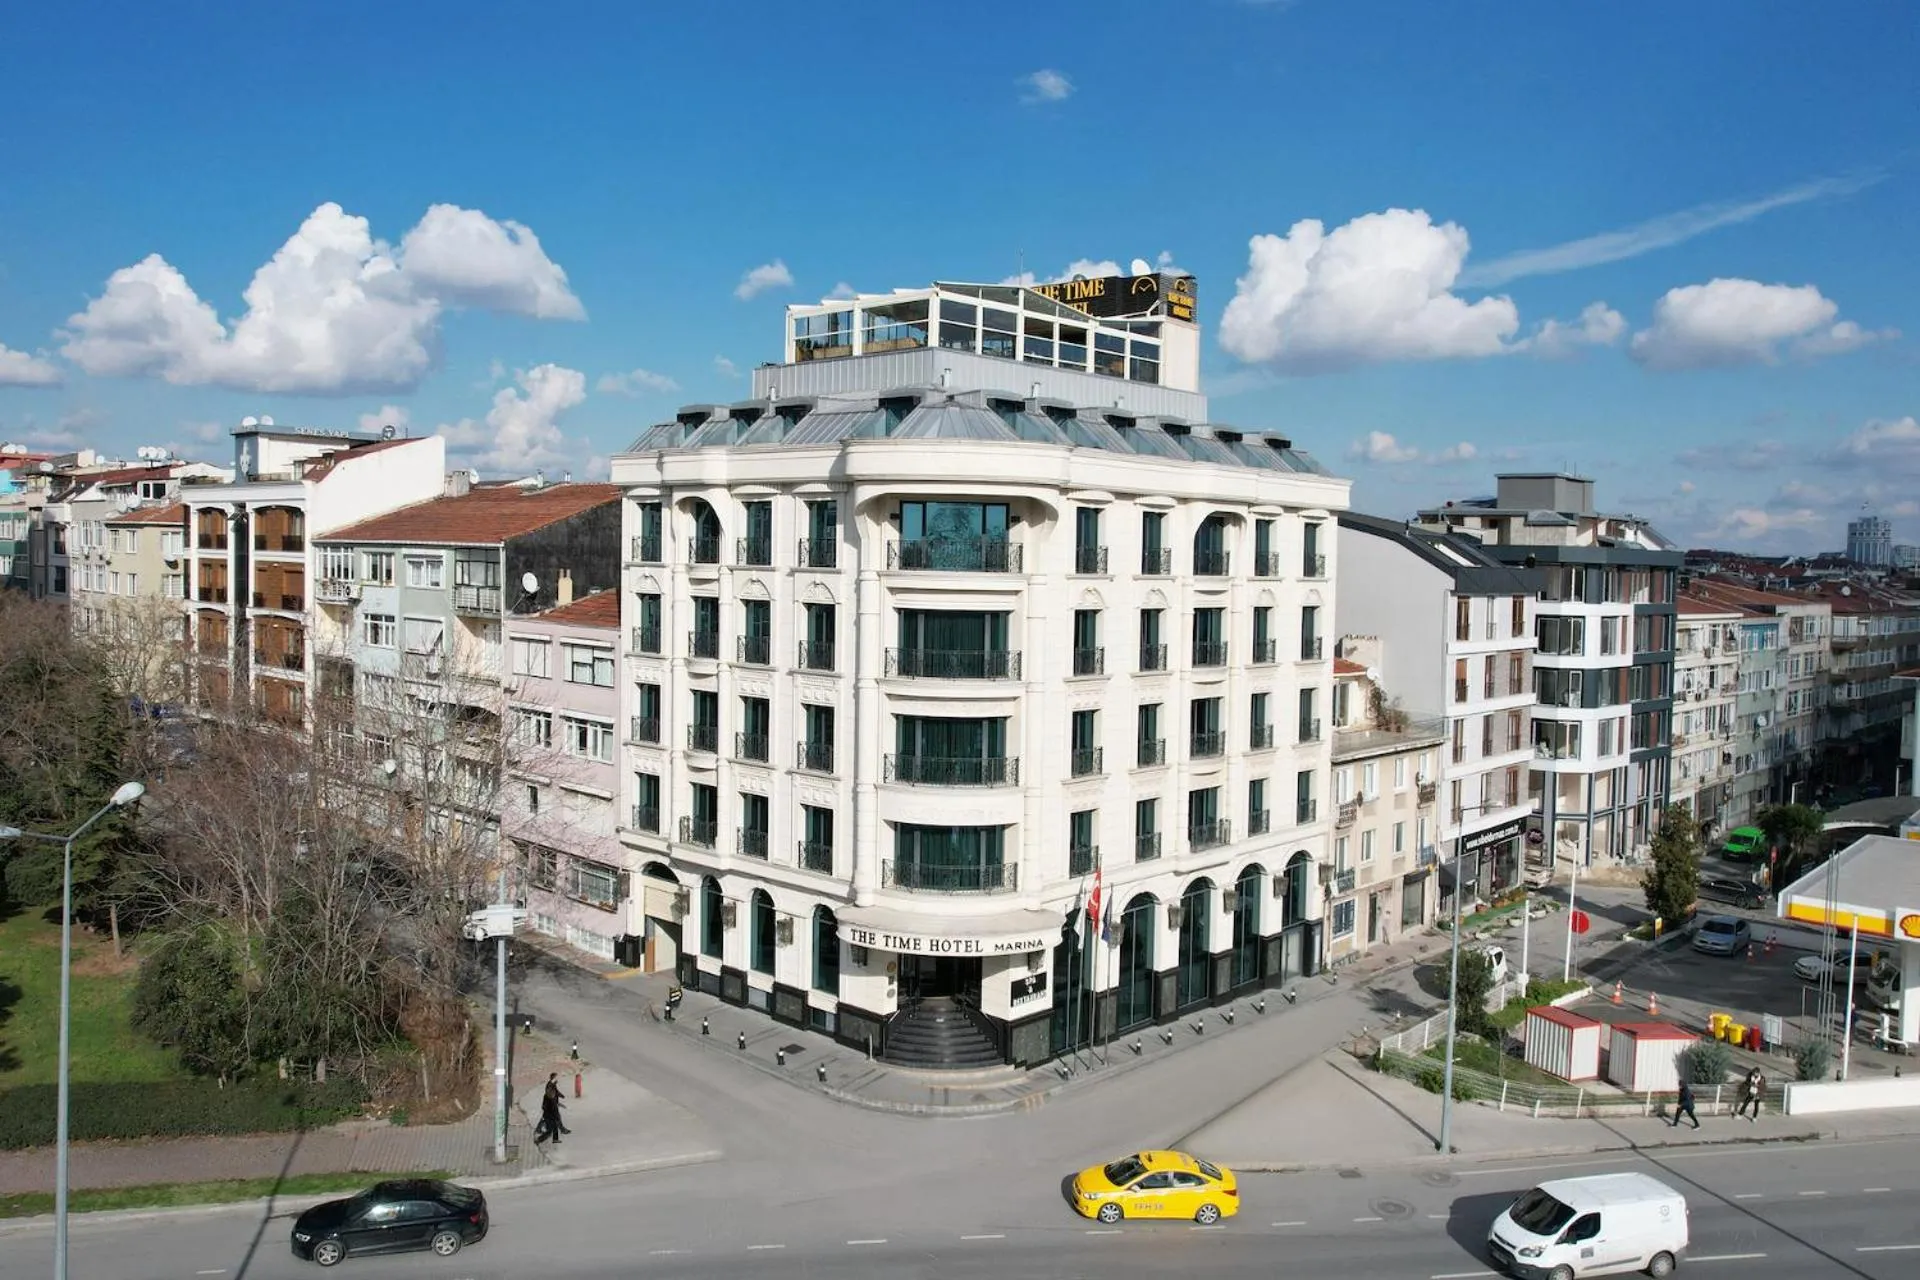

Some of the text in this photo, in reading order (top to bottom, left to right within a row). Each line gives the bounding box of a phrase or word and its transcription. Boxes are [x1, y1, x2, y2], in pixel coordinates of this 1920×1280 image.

[1063, 279, 1105, 300] TIME
[850, 928, 1044, 953] THE TIME HOTEL MARINA
